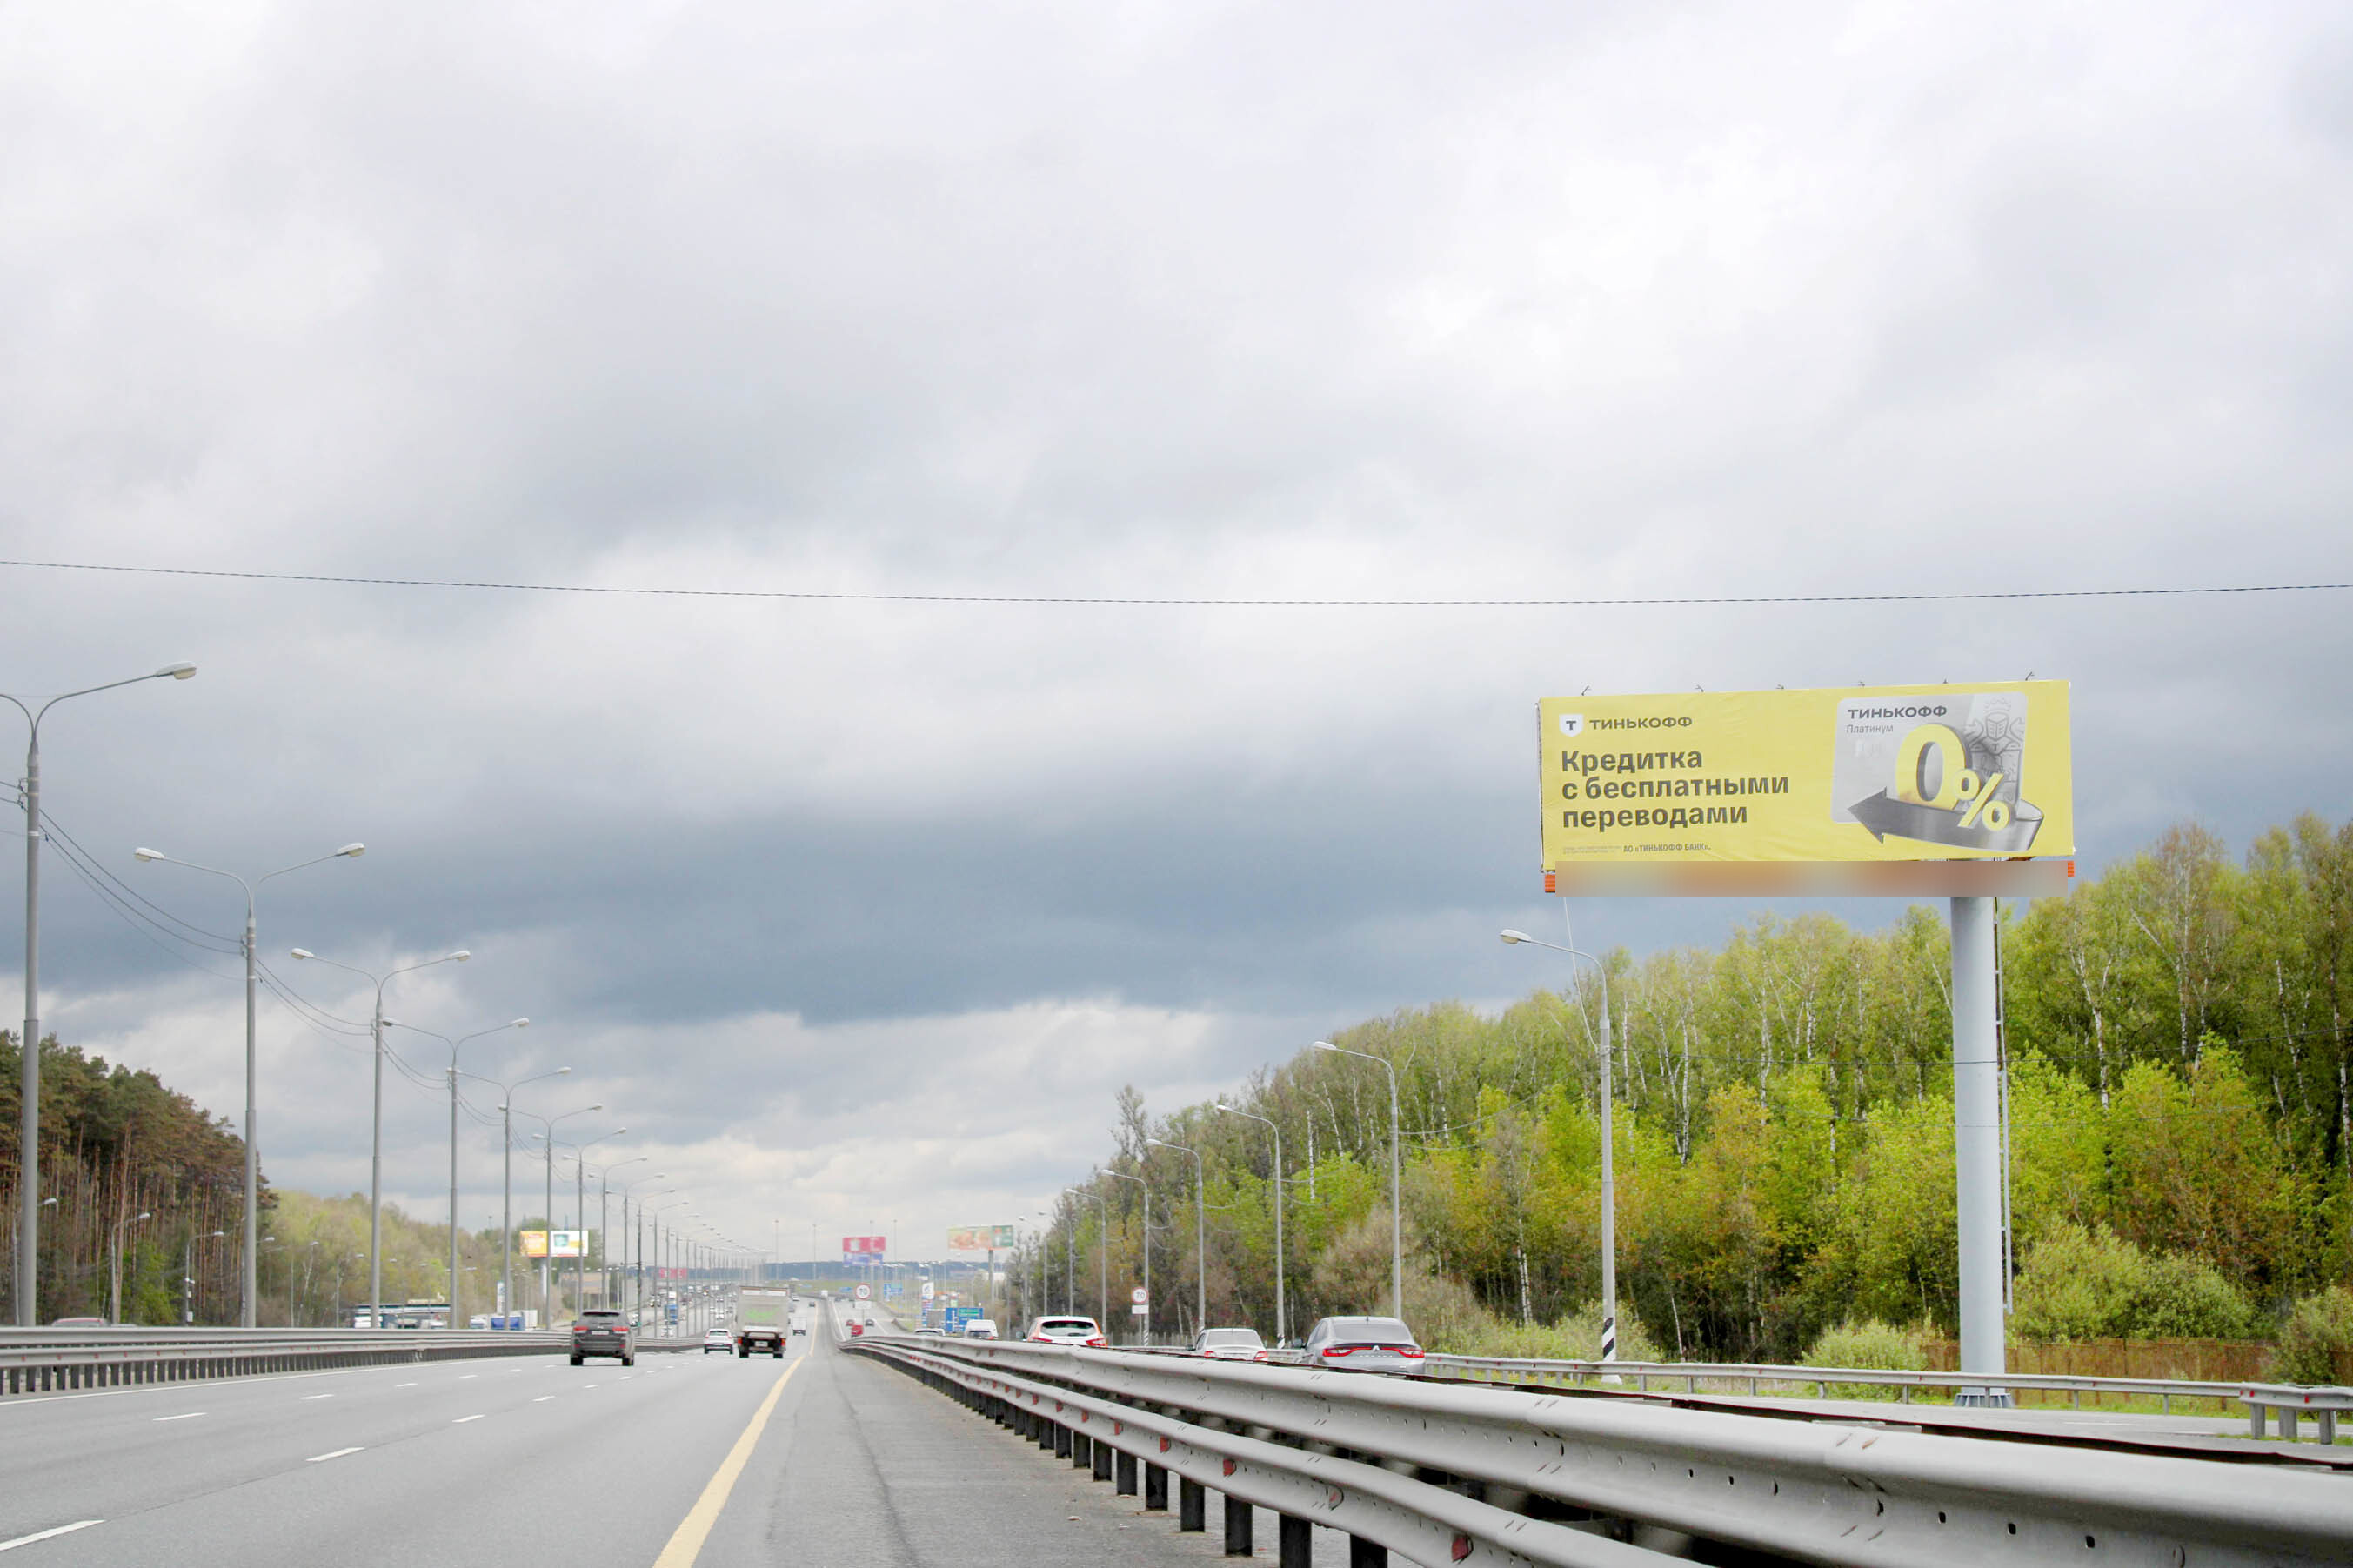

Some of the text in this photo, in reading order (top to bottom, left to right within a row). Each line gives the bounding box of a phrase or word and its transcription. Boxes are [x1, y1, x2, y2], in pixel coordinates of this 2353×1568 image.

[1589, 716, 1693, 731] ТИНЬКОФФ
[1848, 705, 1947, 719] ТИНЬКОФФ
[1846, 724, 1894, 735] Платинум
[1561, 751, 1702, 776] Кредитка
[1562, 777, 1788, 800] с бесплатными
[1896, 723, 2010, 831] 0%
[1563, 806, 1748, 832] переводами
